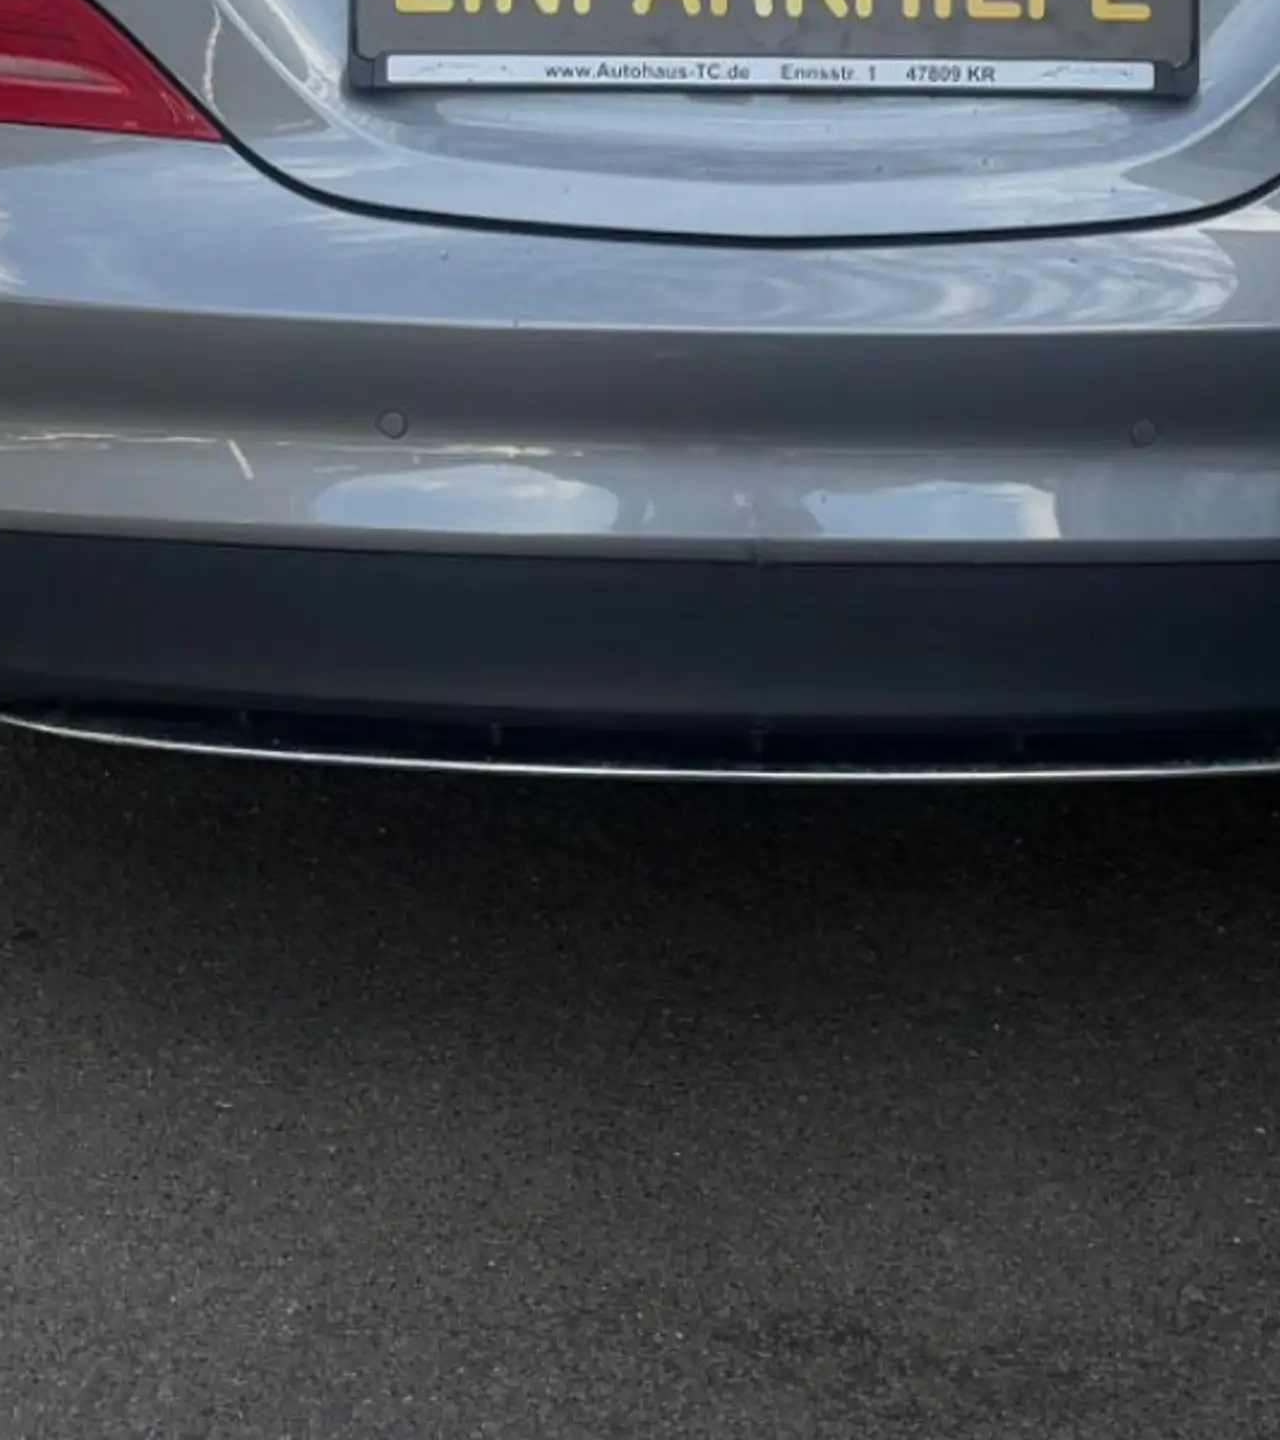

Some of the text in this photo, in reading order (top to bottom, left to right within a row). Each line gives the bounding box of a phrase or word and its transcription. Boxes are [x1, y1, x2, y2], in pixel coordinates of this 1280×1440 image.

[544, 62, 750, 81] www.Autohaus-TC.de
[905, 65, 962, 83] 47809
[967, 66, 997, 83] KR
